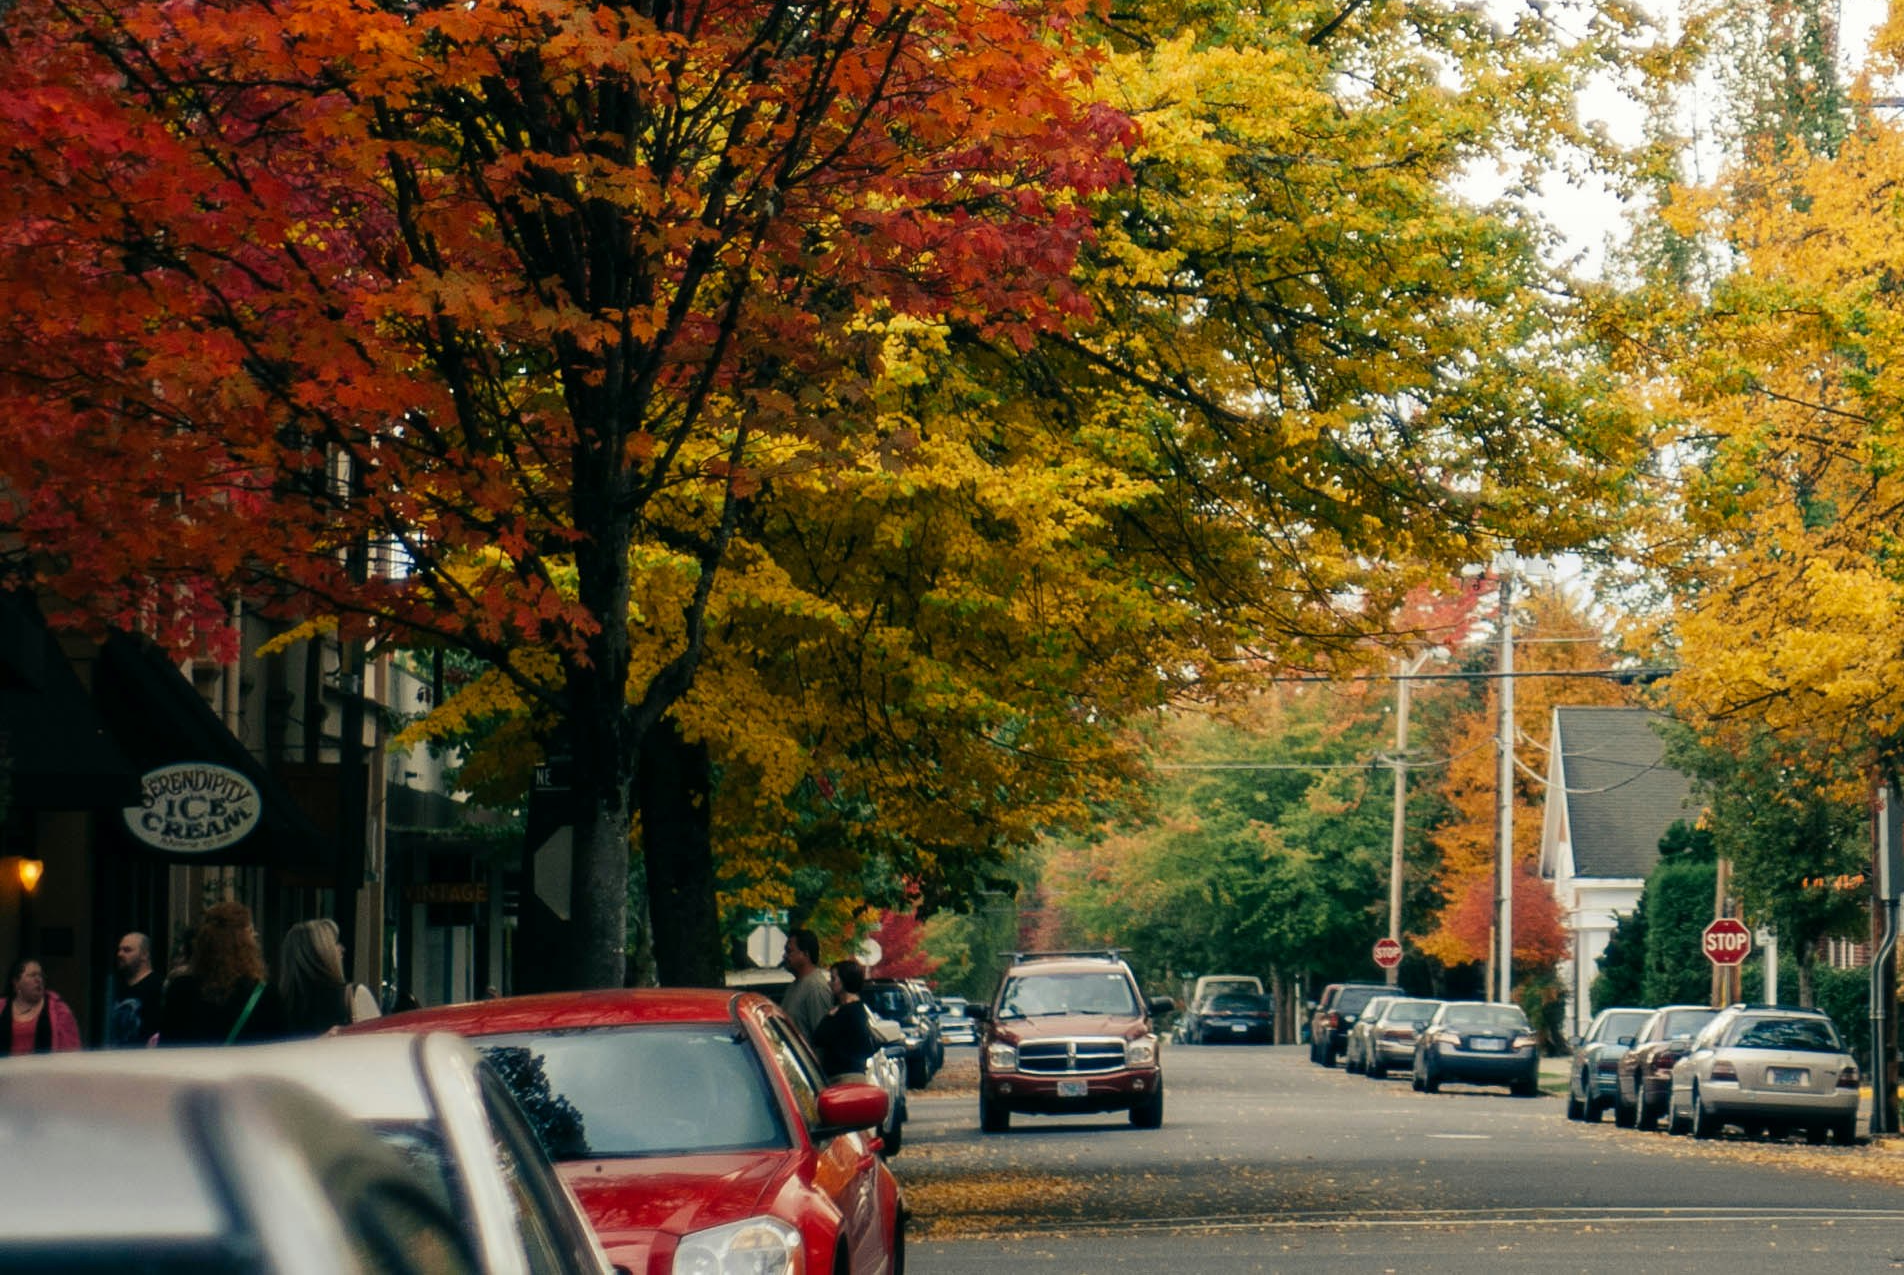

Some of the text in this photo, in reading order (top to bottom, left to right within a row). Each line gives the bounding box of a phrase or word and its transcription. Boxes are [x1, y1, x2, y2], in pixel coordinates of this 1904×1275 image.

[536, 768, 553, 786] NE
[138, 770, 252, 810] SERENDIPITY
[166, 795, 227, 821] ICE
[141, 806, 253, 839] CREAM
[401, 883, 489, 903] VINTAGE
[1706, 932, 1747, 952] STOP
[1375, 946, 1400, 959] STOP
